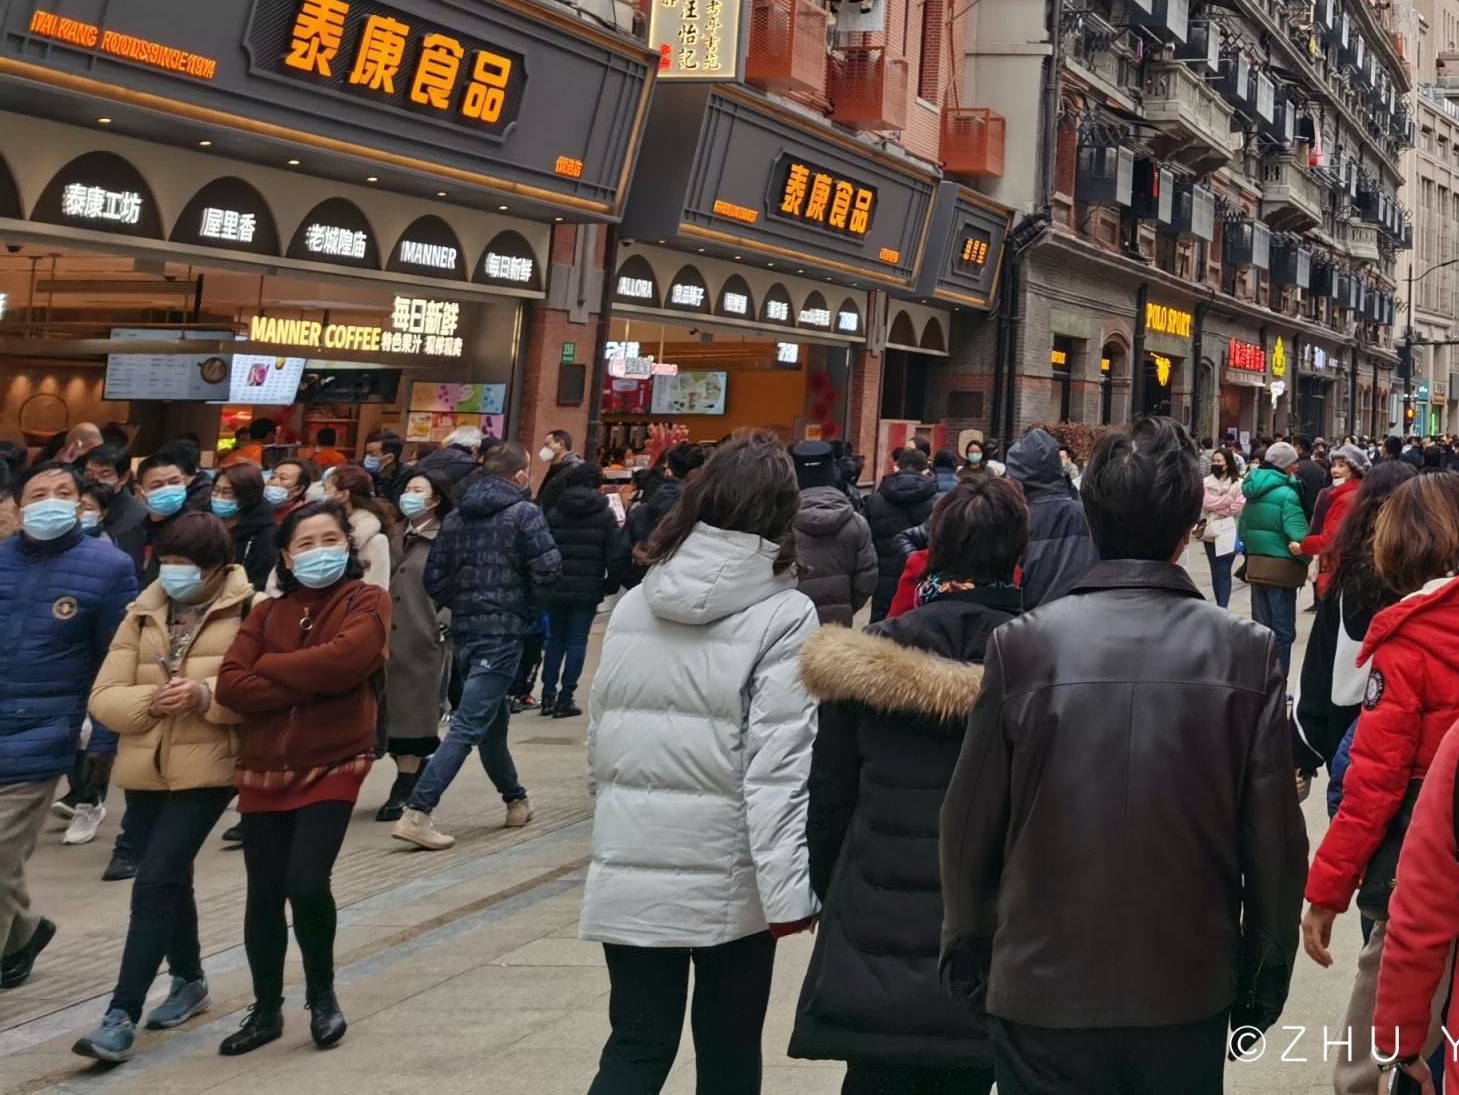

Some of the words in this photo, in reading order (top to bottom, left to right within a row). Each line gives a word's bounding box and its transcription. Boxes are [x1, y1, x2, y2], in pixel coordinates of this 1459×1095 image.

[62, 182, 143, 224] 泰康工坊
[779, 163, 873, 234] 泰康食品
[250, 315, 322, 347] MANNER
[324, 323, 382, 351] COFFEE
[1146, 302, 1167, 331] POLO
[1167, 308, 1191, 338] SPORT
